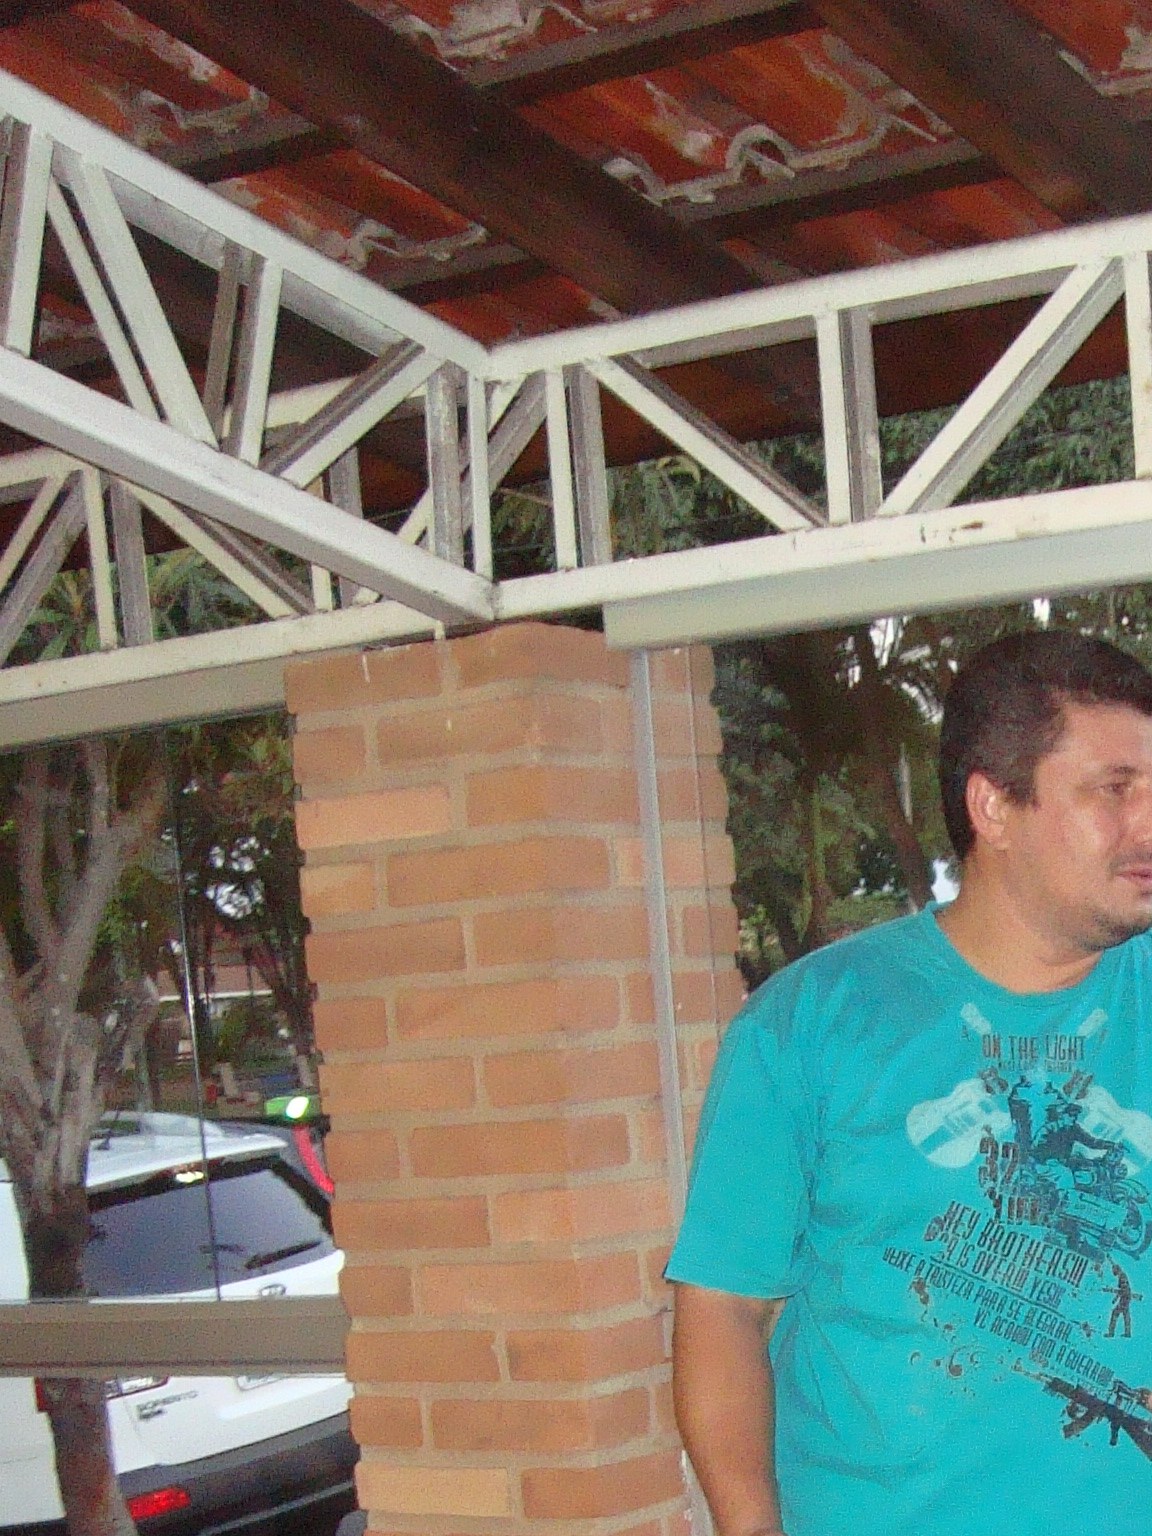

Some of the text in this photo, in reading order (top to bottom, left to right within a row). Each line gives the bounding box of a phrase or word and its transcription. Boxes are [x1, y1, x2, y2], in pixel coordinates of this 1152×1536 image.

[1008, 1035, 1039, 1061] THE
[1045, 1033, 1087, 1061] LIGHT
[943, 1200, 981, 1241] HEY
[1006, 1300, 1025, 1321] SE
